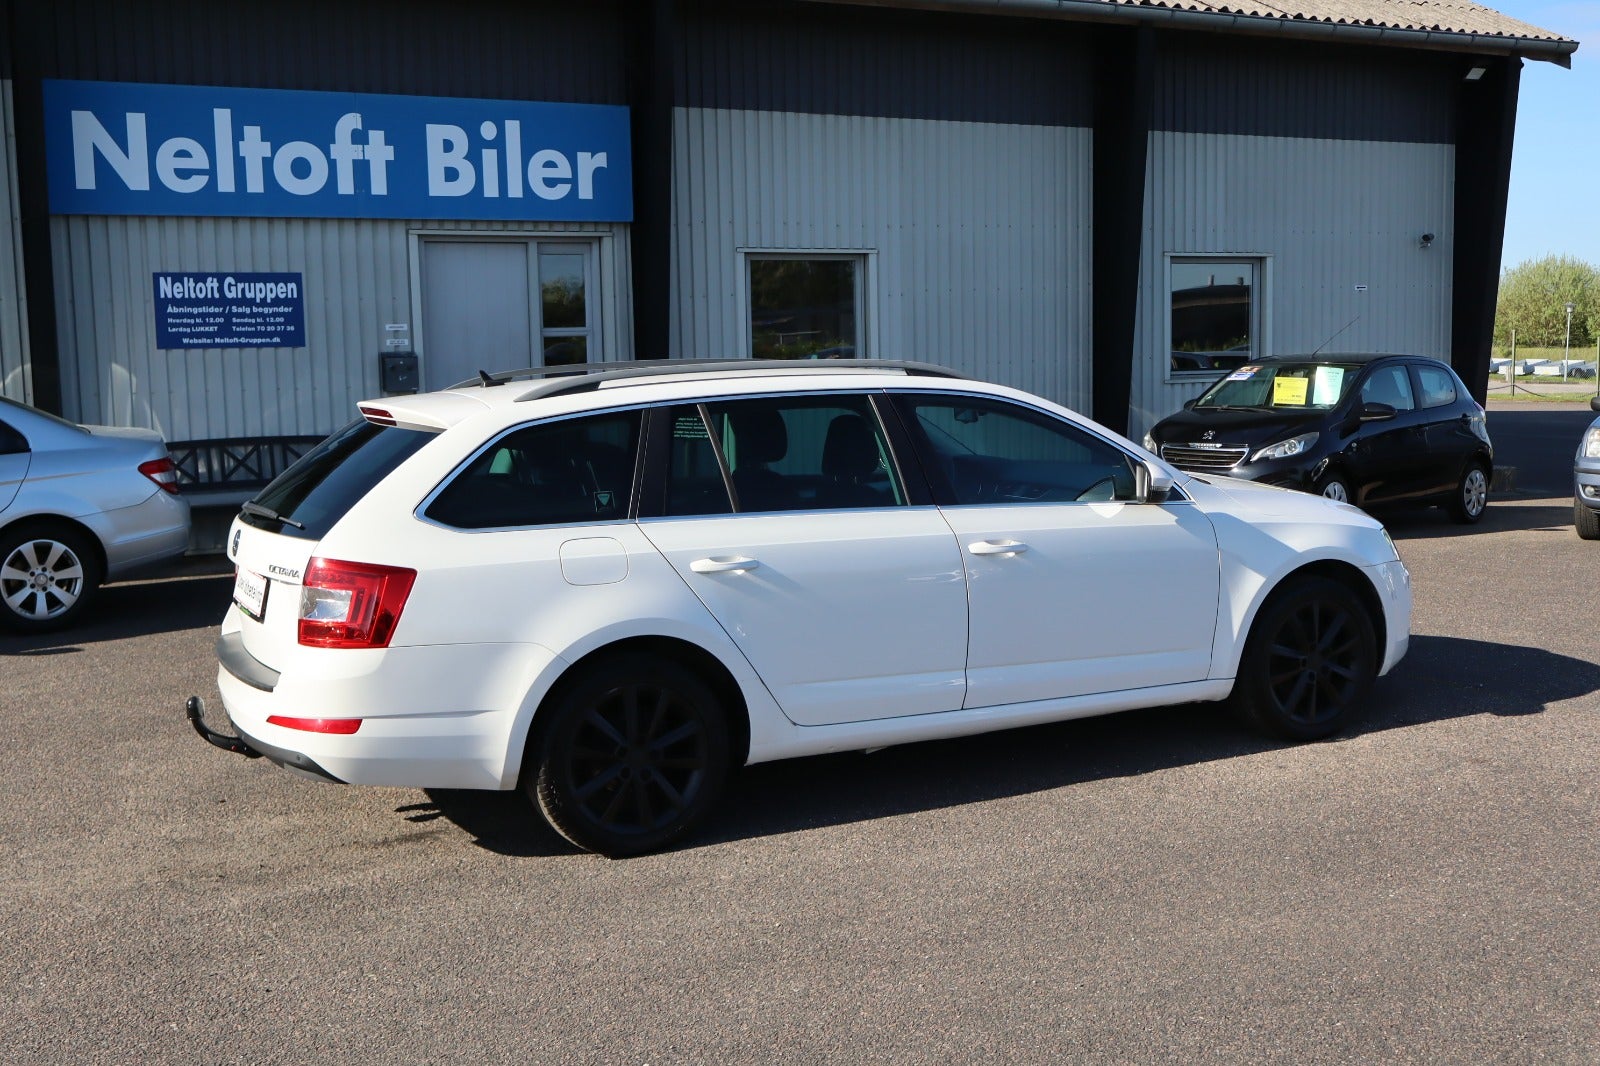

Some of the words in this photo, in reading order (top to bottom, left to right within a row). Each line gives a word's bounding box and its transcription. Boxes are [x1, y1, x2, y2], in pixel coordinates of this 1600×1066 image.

[71, 108, 394, 195] Neltoft
[426, 120, 607, 200] Biler
[159, 276, 220, 299] Neltoft
[223, 276, 298, 303] Gruppen
[167, 303, 223, 314] Åbningstider
[225, 305, 230, 314] /
[231, 305, 251, 314] Salg
[253, 305, 293, 314] begynder
[214, 336, 281, 344] Neltoft-Gruppen.dk
